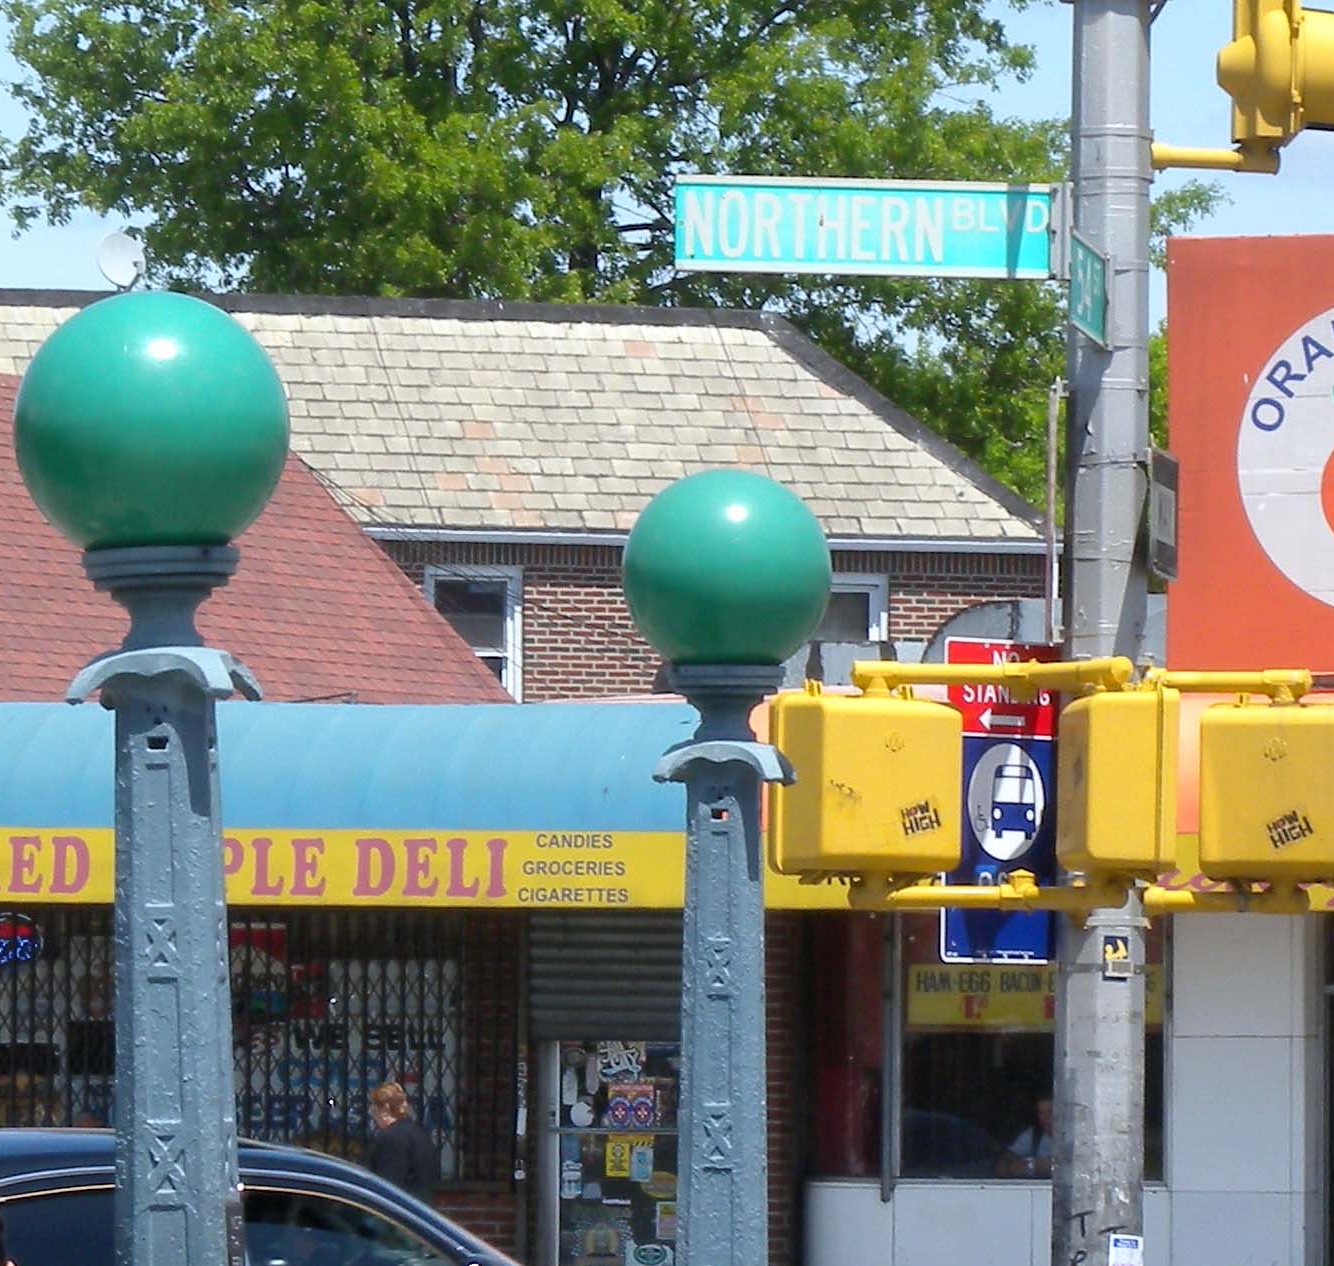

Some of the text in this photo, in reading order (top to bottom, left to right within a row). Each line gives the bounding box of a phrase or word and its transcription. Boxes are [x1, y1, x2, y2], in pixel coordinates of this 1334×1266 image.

[683, 189, 1049, 264] NORTHERN BLVD
[900, 800, 930, 820] HOW
[902, 808, 942, 835] HIGH
[1266, 810, 1299, 833] HOW
[536, 834, 614, 849] CANDIES
[1270, 816, 1314, 848] HIGH
[352, 838, 508, 898] DELI
[522, 861, 627, 876] GROCERIES
[517, 888, 629, 902] CIGARETTES
